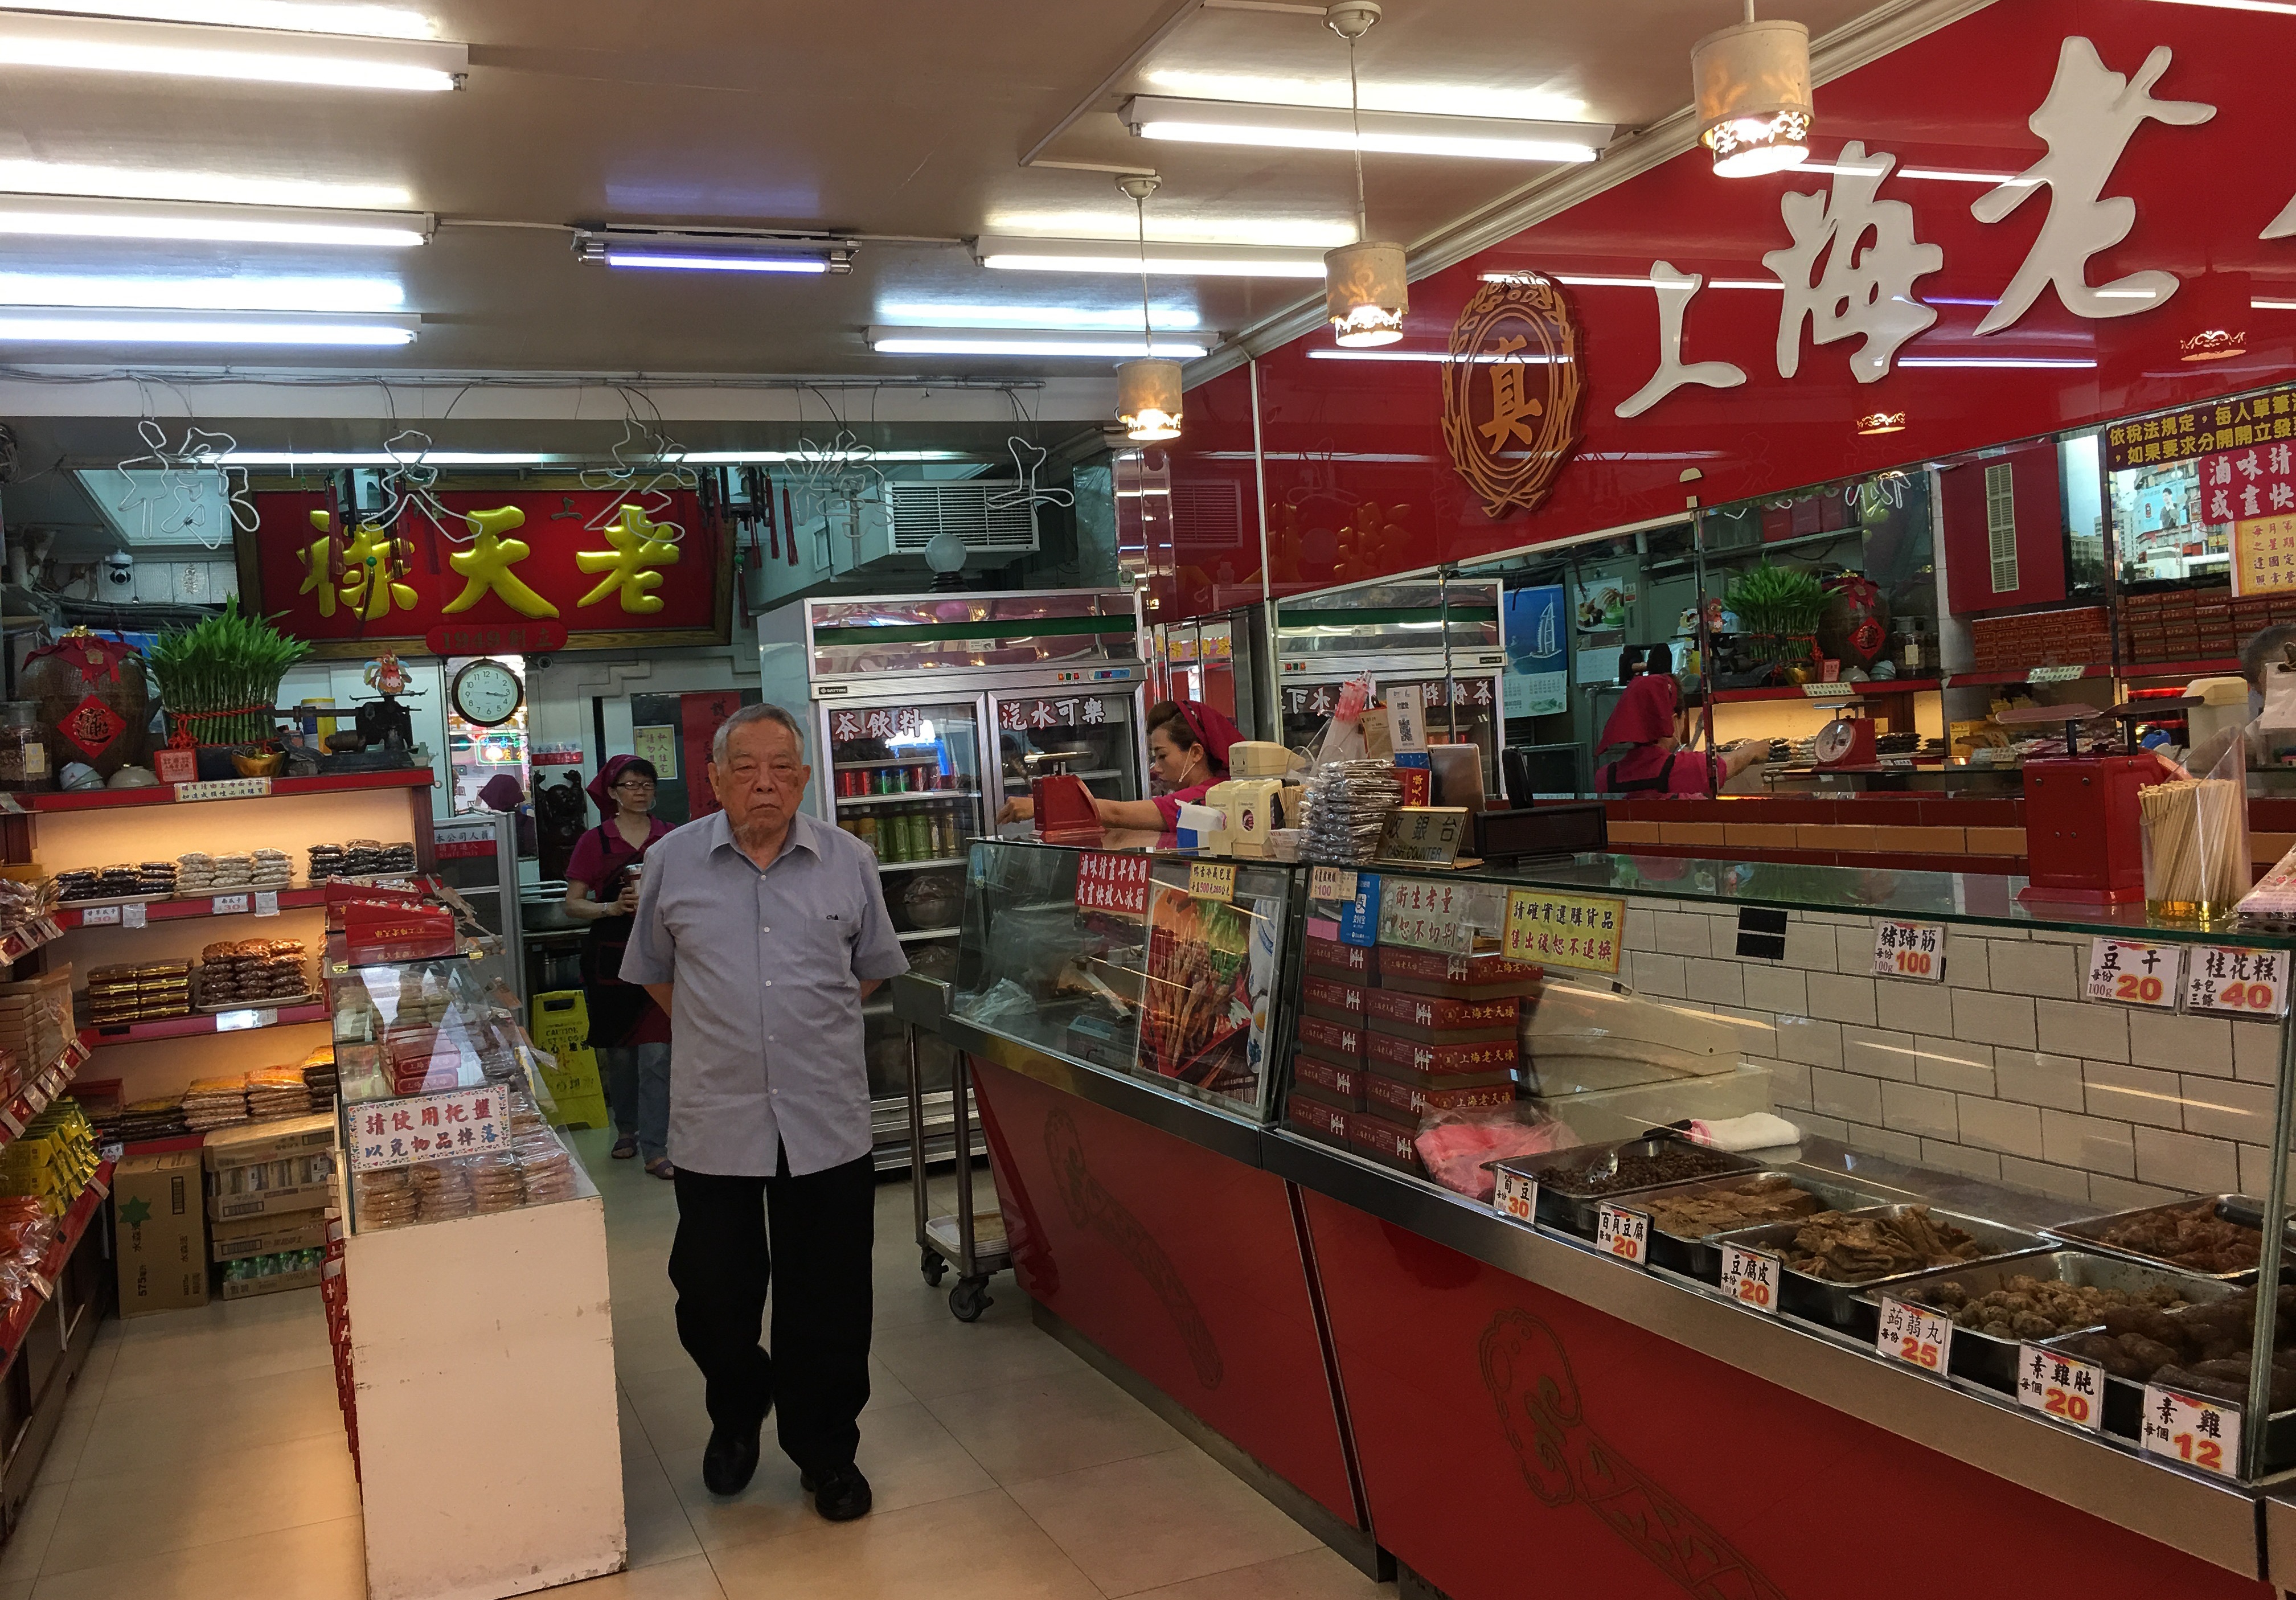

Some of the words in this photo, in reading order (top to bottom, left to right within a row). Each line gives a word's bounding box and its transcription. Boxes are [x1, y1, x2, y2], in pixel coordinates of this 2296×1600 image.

[1614, 35, 2296, 419] 上海老
[1479, 334, 1543, 456] 真
[2110, 392, 2296, 446] 依稅法規定，每人單筆
[2115, 416, 2296, 465] ，如果要求分開開立發
[2209, 444, 2292, 486] 滷味請
[2211, 482, 2294, 519] 或盡快
[835, 707, 924, 742] 茶飲料
[1000, 697, 1106, 730] 汽水可樂
[436, 830, 488, 843] 本公司人員
[1387, 815, 1457, 842] 收銀台
[1407, 846, 1442, 860] COUNTER
[1396, 883, 1453, 913] 衛生考量
[1514, 901, 1614, 929] 請確實選購貨品
[1511, 929, 1612, 962] 售出後恕不退換
[1881, 925, 1936, 952] 豬蹄筋
[1874, 961, 1893, 973] 100g
[1875, 948, 1893, 959] 每份
[1896, 950, 1931, 974] 100
[2101, 945, 2161, 974] 豆干
[2205, 951, 2277, 983] 桂花糕
[2089, 983, 2113, 997] 100g
[2091, 969, 2114, 983] 每份
[2115, 974, 2163, 1002] 20
[2190, 994, 2215, 1007] 三條
[2191, 979, 2216, 994] 每包
[2220, 982, 2272, 1010] 40
[1461, 1006, 1515, 1019] 上海老天祿
[1460, 1049, 1514, 1064] 上海老天祿
[365, 1098, 493, 1136] 請使用托盤
[365, 1123, 499, 1158] 以免物品掉落
[1508, 1196, 1529, 1217] 30
[1601, 1212, 1644, 1241] 百頁豆腐
[1613, 1236, 1637, 1258] 20
[1731, 1254, 1770, 1286] 豆腐皮
[1740, 1280, 1769, 1305] 20
[1887, 1307, 1942, 1344] 蒟蒻丸
[1881, 1328, 1900, 1343] 每份
[1901, 1337, 1937, 1367] 25
[2030, 1354, 2094, 1395] 素雞肫
[2020, 1377, 2043, 1396] 每個
[2045, 1388, 2088, 1421] 20
[2156, 1397, 2221, 1438] 素雞
[2144, 1422, 2168, 1442] 每個
[2174, 1434, 2221, 1468] 12
